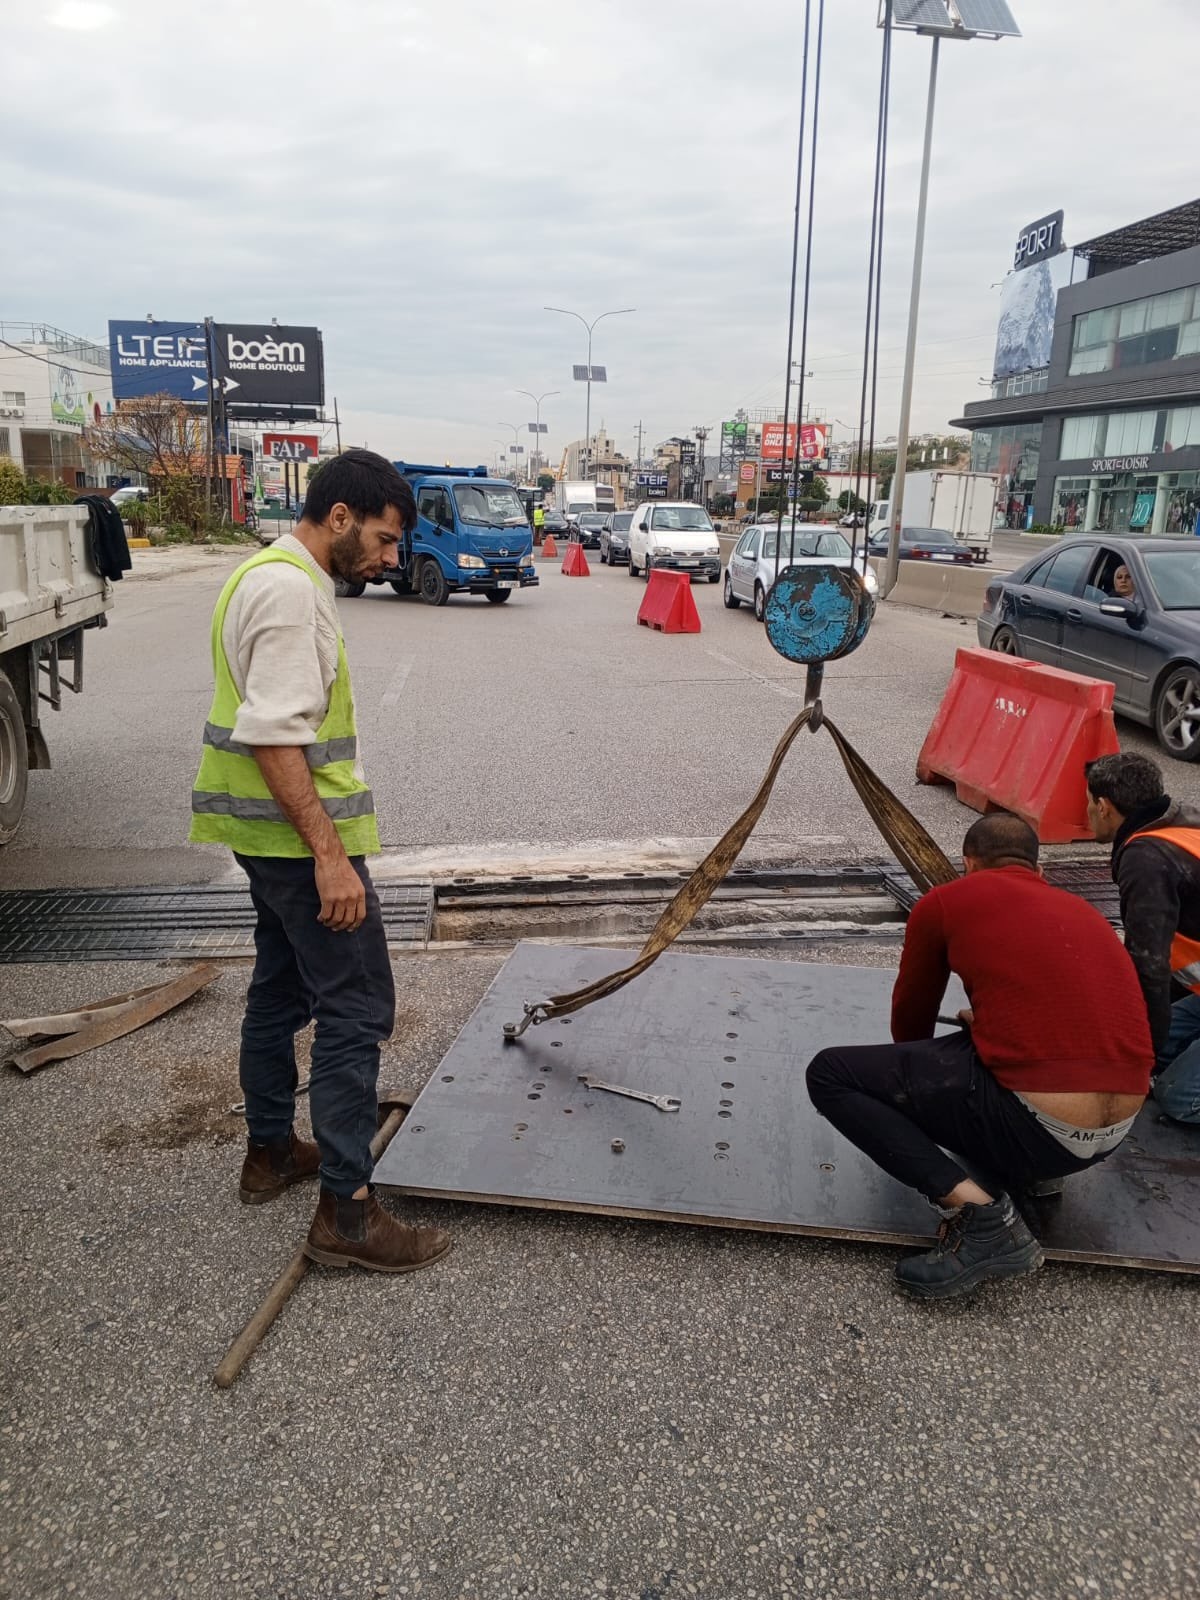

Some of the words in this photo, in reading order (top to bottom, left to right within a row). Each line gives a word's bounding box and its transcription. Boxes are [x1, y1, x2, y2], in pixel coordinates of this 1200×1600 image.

[117, 334, 207, 358] LTEIF
[227, 333, 305, 362] boèm
[119, 357, 147, 366] HOME
[149, 358, 207, 368] APPLIANCES
[229, 361, 257, 370] HOME
[258, 362, 305, 373] BOUTIQUE
[1091, 458, 1117, 472] SPORT
[1120, 456, 1149, 470] LOISIR
[637, 475, 668, 485] LTEIF
